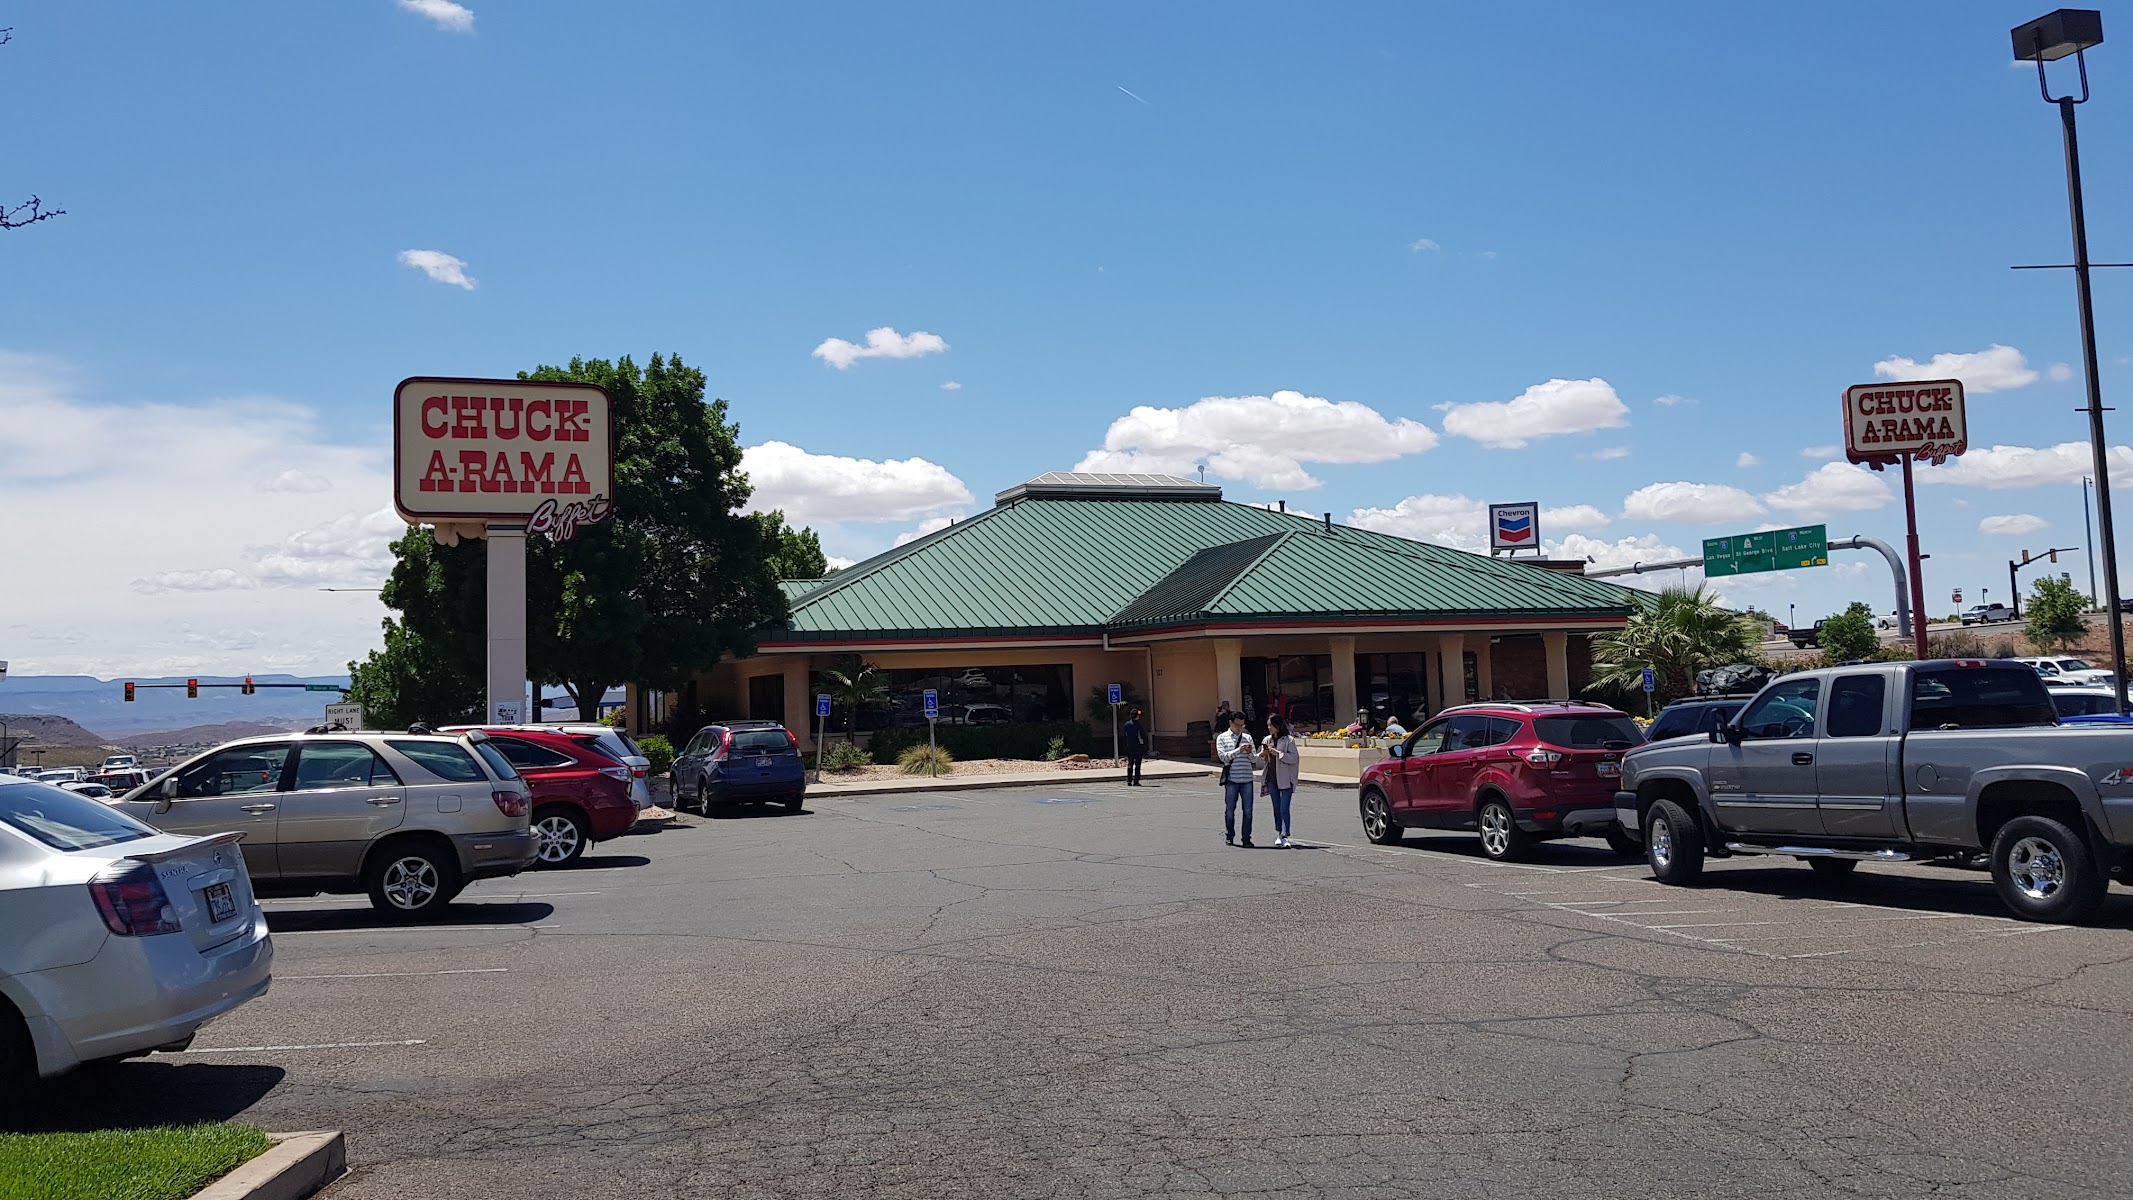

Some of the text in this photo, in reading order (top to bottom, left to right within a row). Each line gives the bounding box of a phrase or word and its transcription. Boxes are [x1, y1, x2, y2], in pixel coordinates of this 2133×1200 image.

[1858, 388, 1953, 416] CHUCK-
[421, 395, 591, 442] CHUCK-
[1862, 416, 1955, 444] A-RAMA
[1913, 440, 1965, 466] Buffet
[419, 449, 591, 495] A-RAMA
[526, 493, 609, 542] Buffet
[1742, 549, 1760, 557] George
[334, 717, 354, 725] MUST
[161, 865, 190, 880] SENTRA
